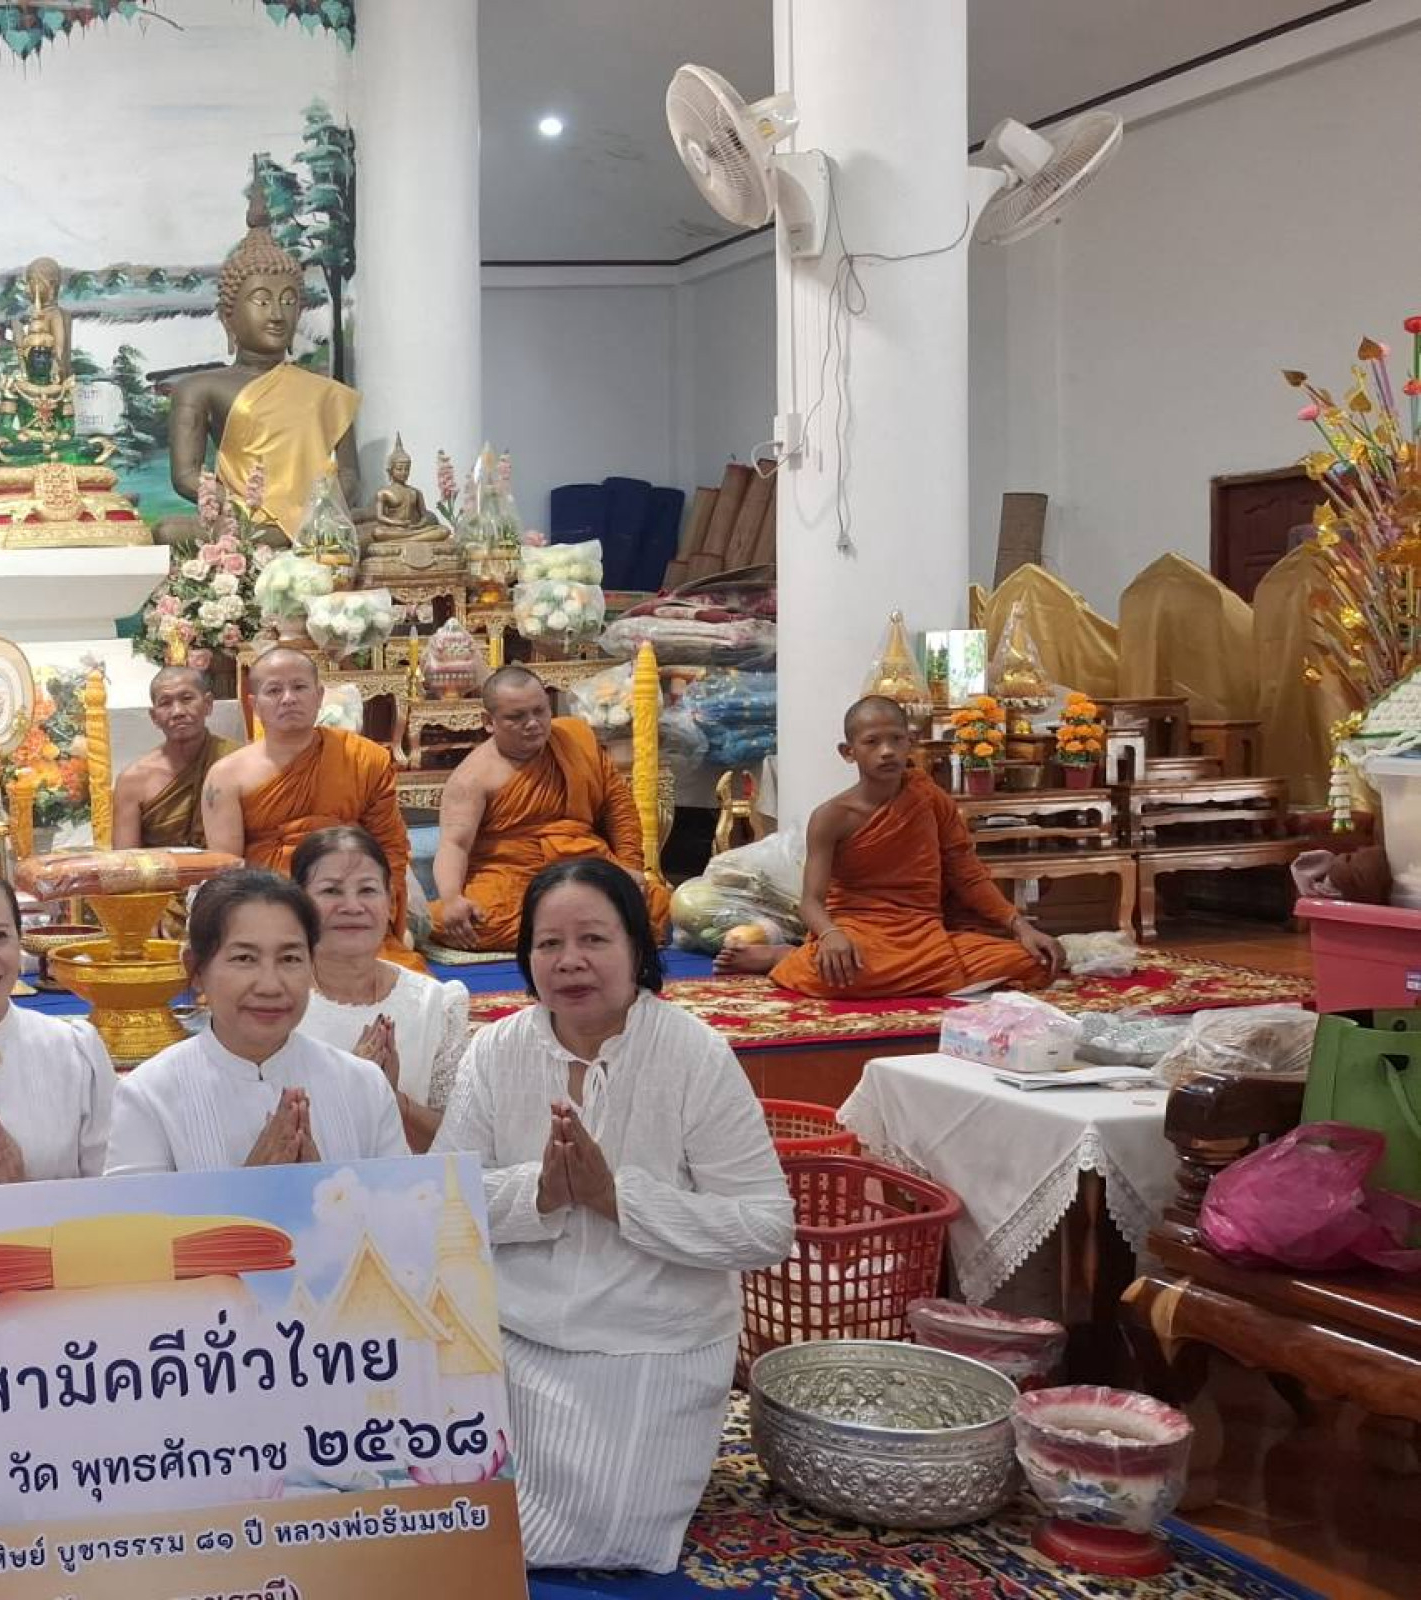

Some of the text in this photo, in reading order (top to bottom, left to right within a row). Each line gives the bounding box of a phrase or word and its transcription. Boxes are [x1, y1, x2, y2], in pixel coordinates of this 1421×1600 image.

[8, 1450, 59, 1494] วัด
[72, 1438, 287, 1502] พุทธศักราช
[303, 1411, 489, 1467] ๒๕๖๘
[57, 1534, 184, 1573] บูชาธรรม
[195, 1531, 234, 1551] ๘๑
[244, 1517, 264, 1546] ปี
[274, 1501, 487, 1544] หลวงพ่อธัมมชโย
